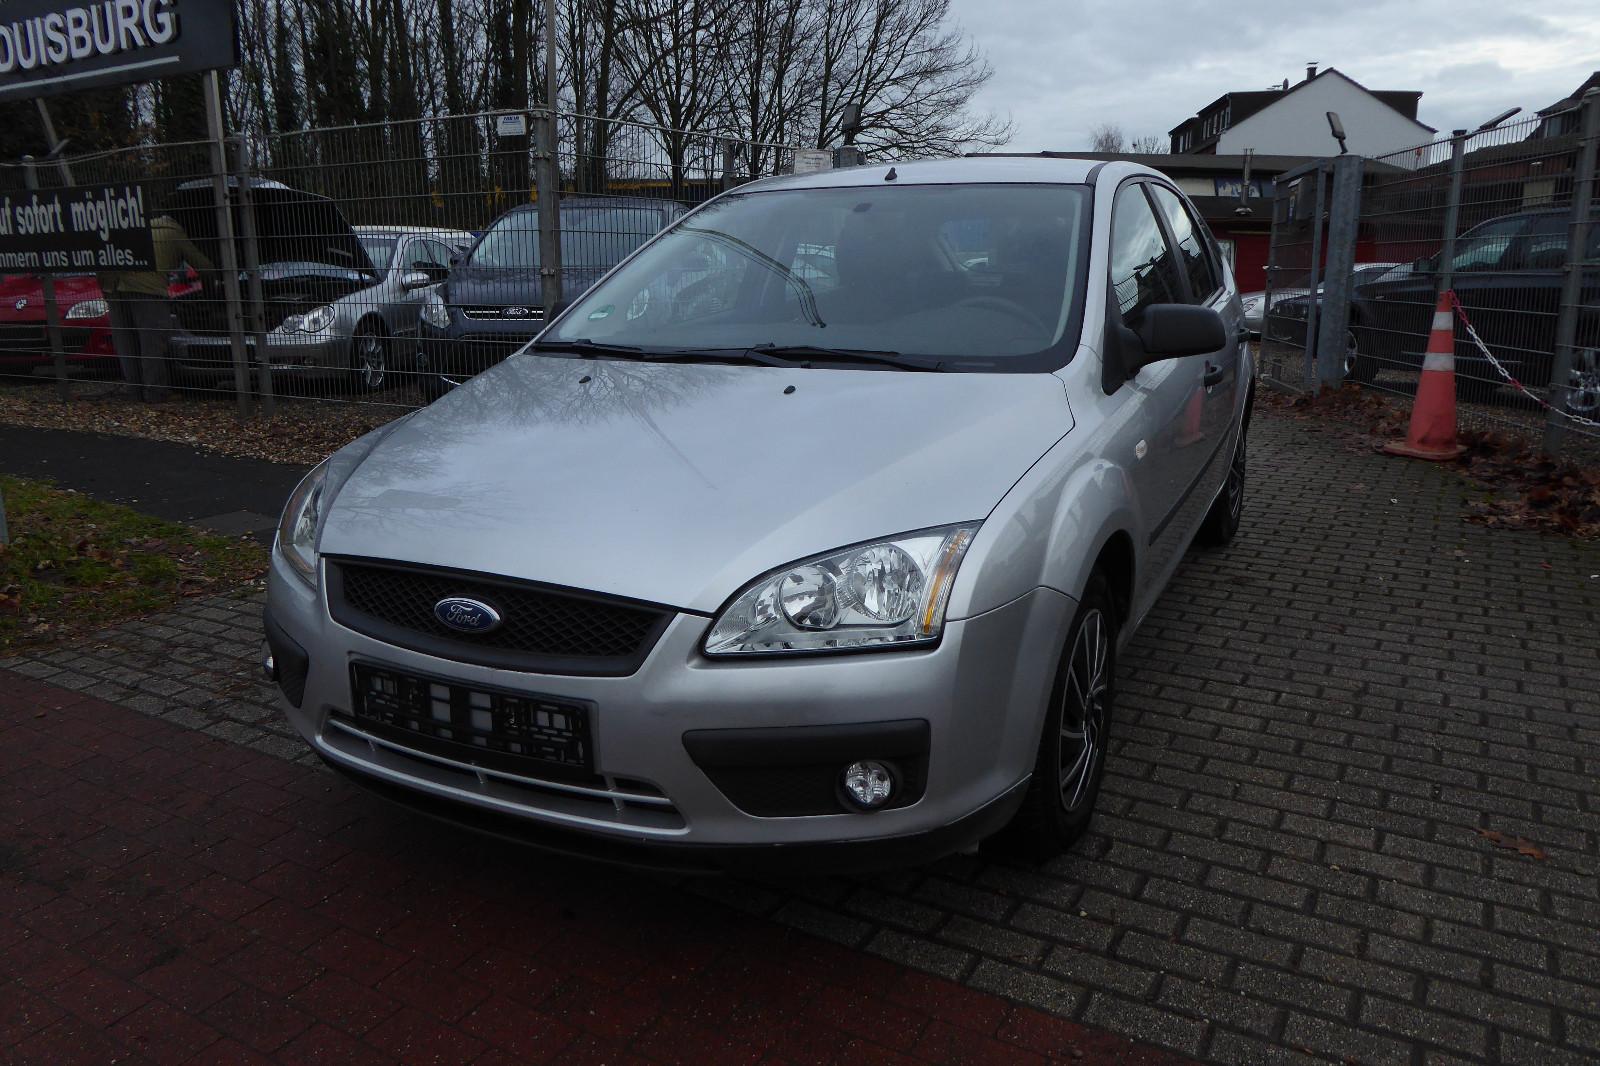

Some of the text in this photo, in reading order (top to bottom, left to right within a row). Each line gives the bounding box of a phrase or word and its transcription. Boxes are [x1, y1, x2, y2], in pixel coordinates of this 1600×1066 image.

[16, 194, 64, 235] sofort
[70, 186, 146, 241] möglich!
[42, 250, 69, 267] uns
[72, 249, 95, 266] um
[98, 244, 148, 266] alles...
[446, 604, 482, 626] Ford
